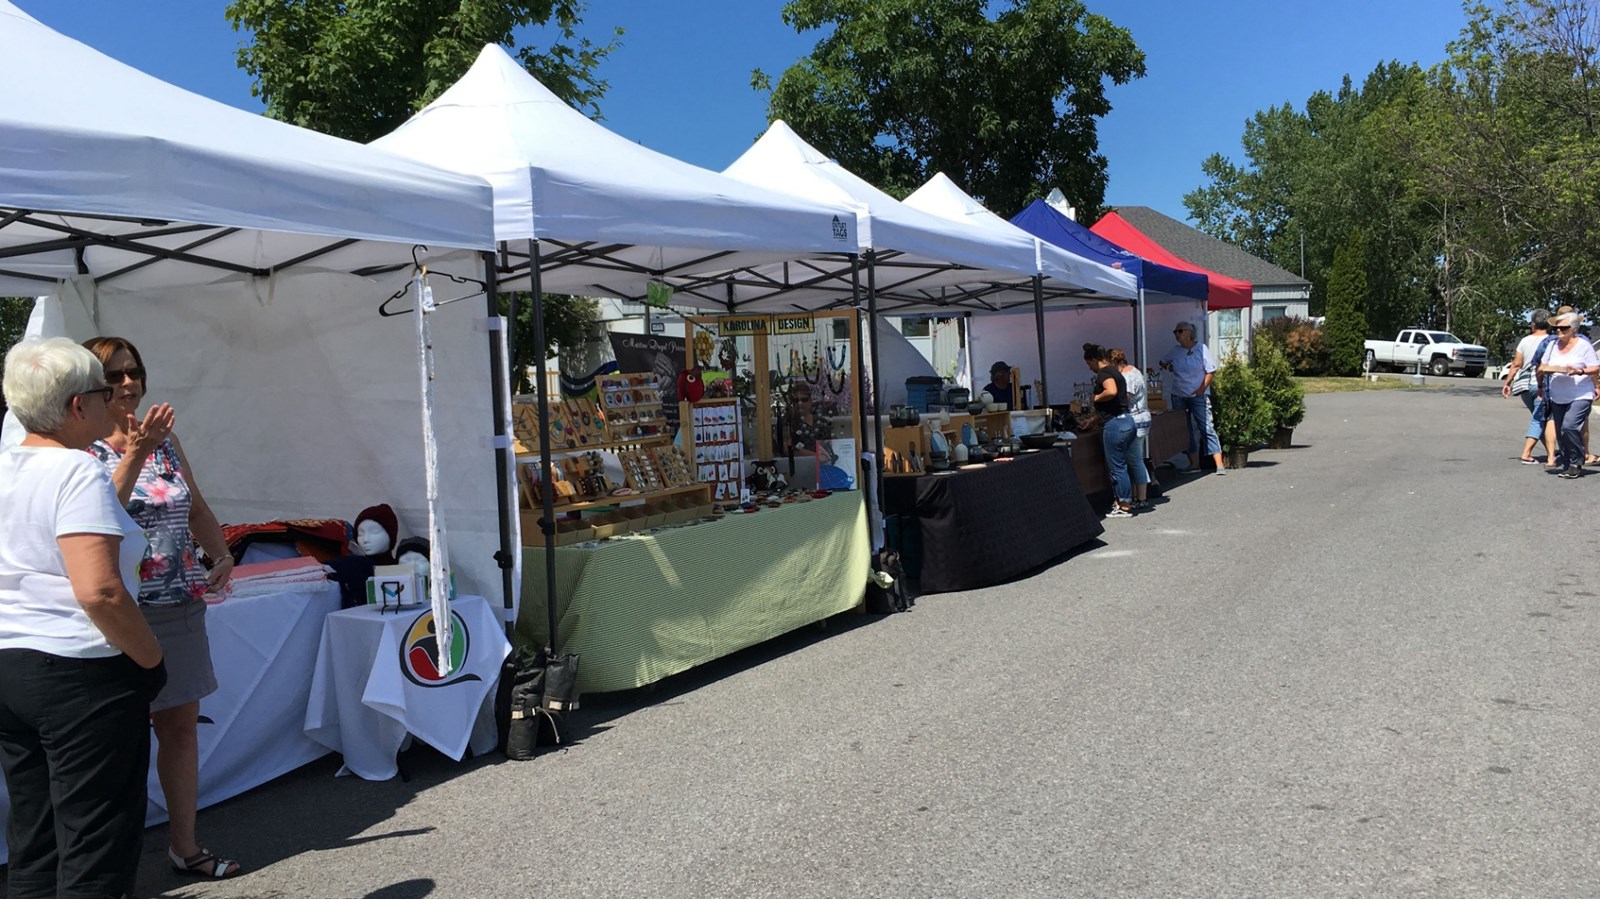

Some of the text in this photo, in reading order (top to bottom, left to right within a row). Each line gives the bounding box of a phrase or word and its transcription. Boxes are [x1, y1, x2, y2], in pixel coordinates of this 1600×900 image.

[832, 228, 848, 238] TAGS
[723, 319, 767, 331] KAROLINA
[778, 317, 810, 330] DESIGN
